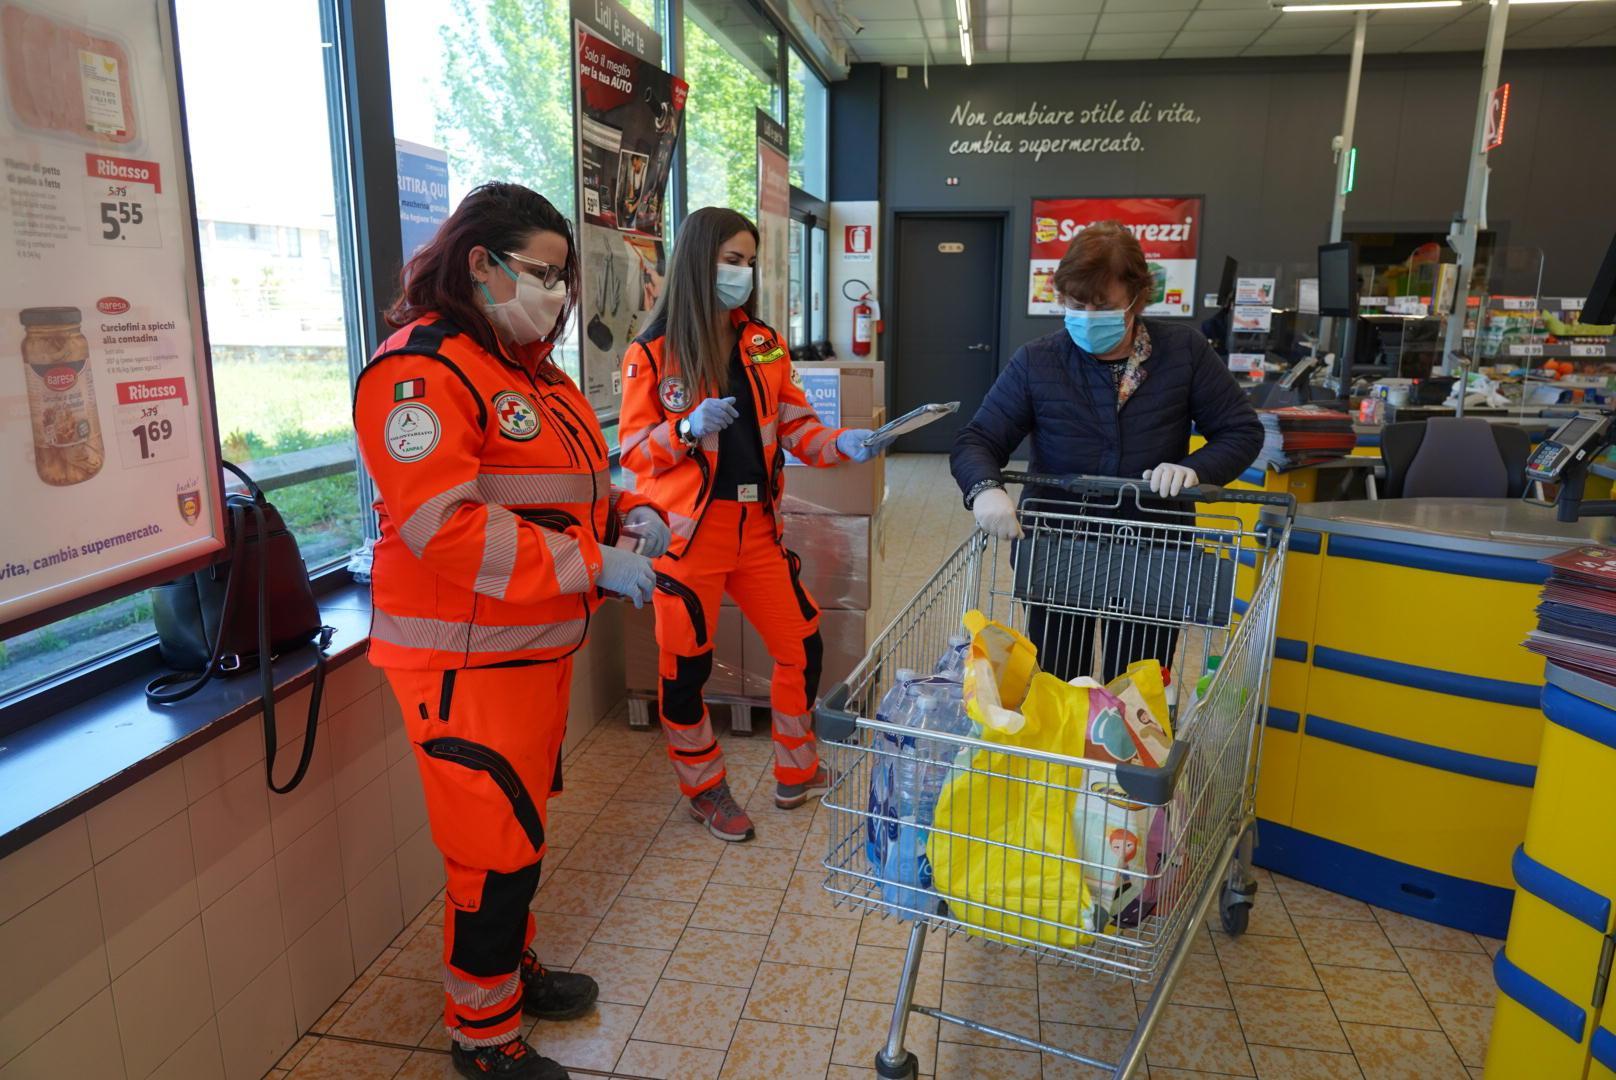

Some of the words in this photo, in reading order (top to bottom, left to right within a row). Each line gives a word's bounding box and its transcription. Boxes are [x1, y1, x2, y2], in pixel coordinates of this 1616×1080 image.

[621, 25, 635, 47] per
[636, 33, 645, 54] te
[584, 46, 599, 62] Solo
[600, 54, 606, 67] il
[606, 59, 631, 78] meglio
[580, 63, 592, 76] per
[591, 66, 598, 80] la
[598, 71, 610, 85] tua
[611, 77, 632, 93] AUTO
[950, 101, 987, 126] Non
[993, 101, 1075, 126] cambiare
[1080, 100, 1125, 123] stile
[1129, 101, 1152, 123] di
[1157, 102, 1201, 124] vita,
[949, 131, 1013, 154] cambia
[1019, 132, 1145, 162] supermercato.
[97, 159, 149, 180] Ribasso
[430, 183, 447, 199] QUI
[101, 322, 140, 333] Carciofini
[148, 321, 176, 332] spicchi
[103, 336, 117, 344] alla
[118, 334, 158, 344] contadina
[128, 384, 177, 400] Ribasso
[816, 388, 836, 400] QUI
[33, 545, 80, 570] cambia
[81, 523, 163, 556] supermercato.
